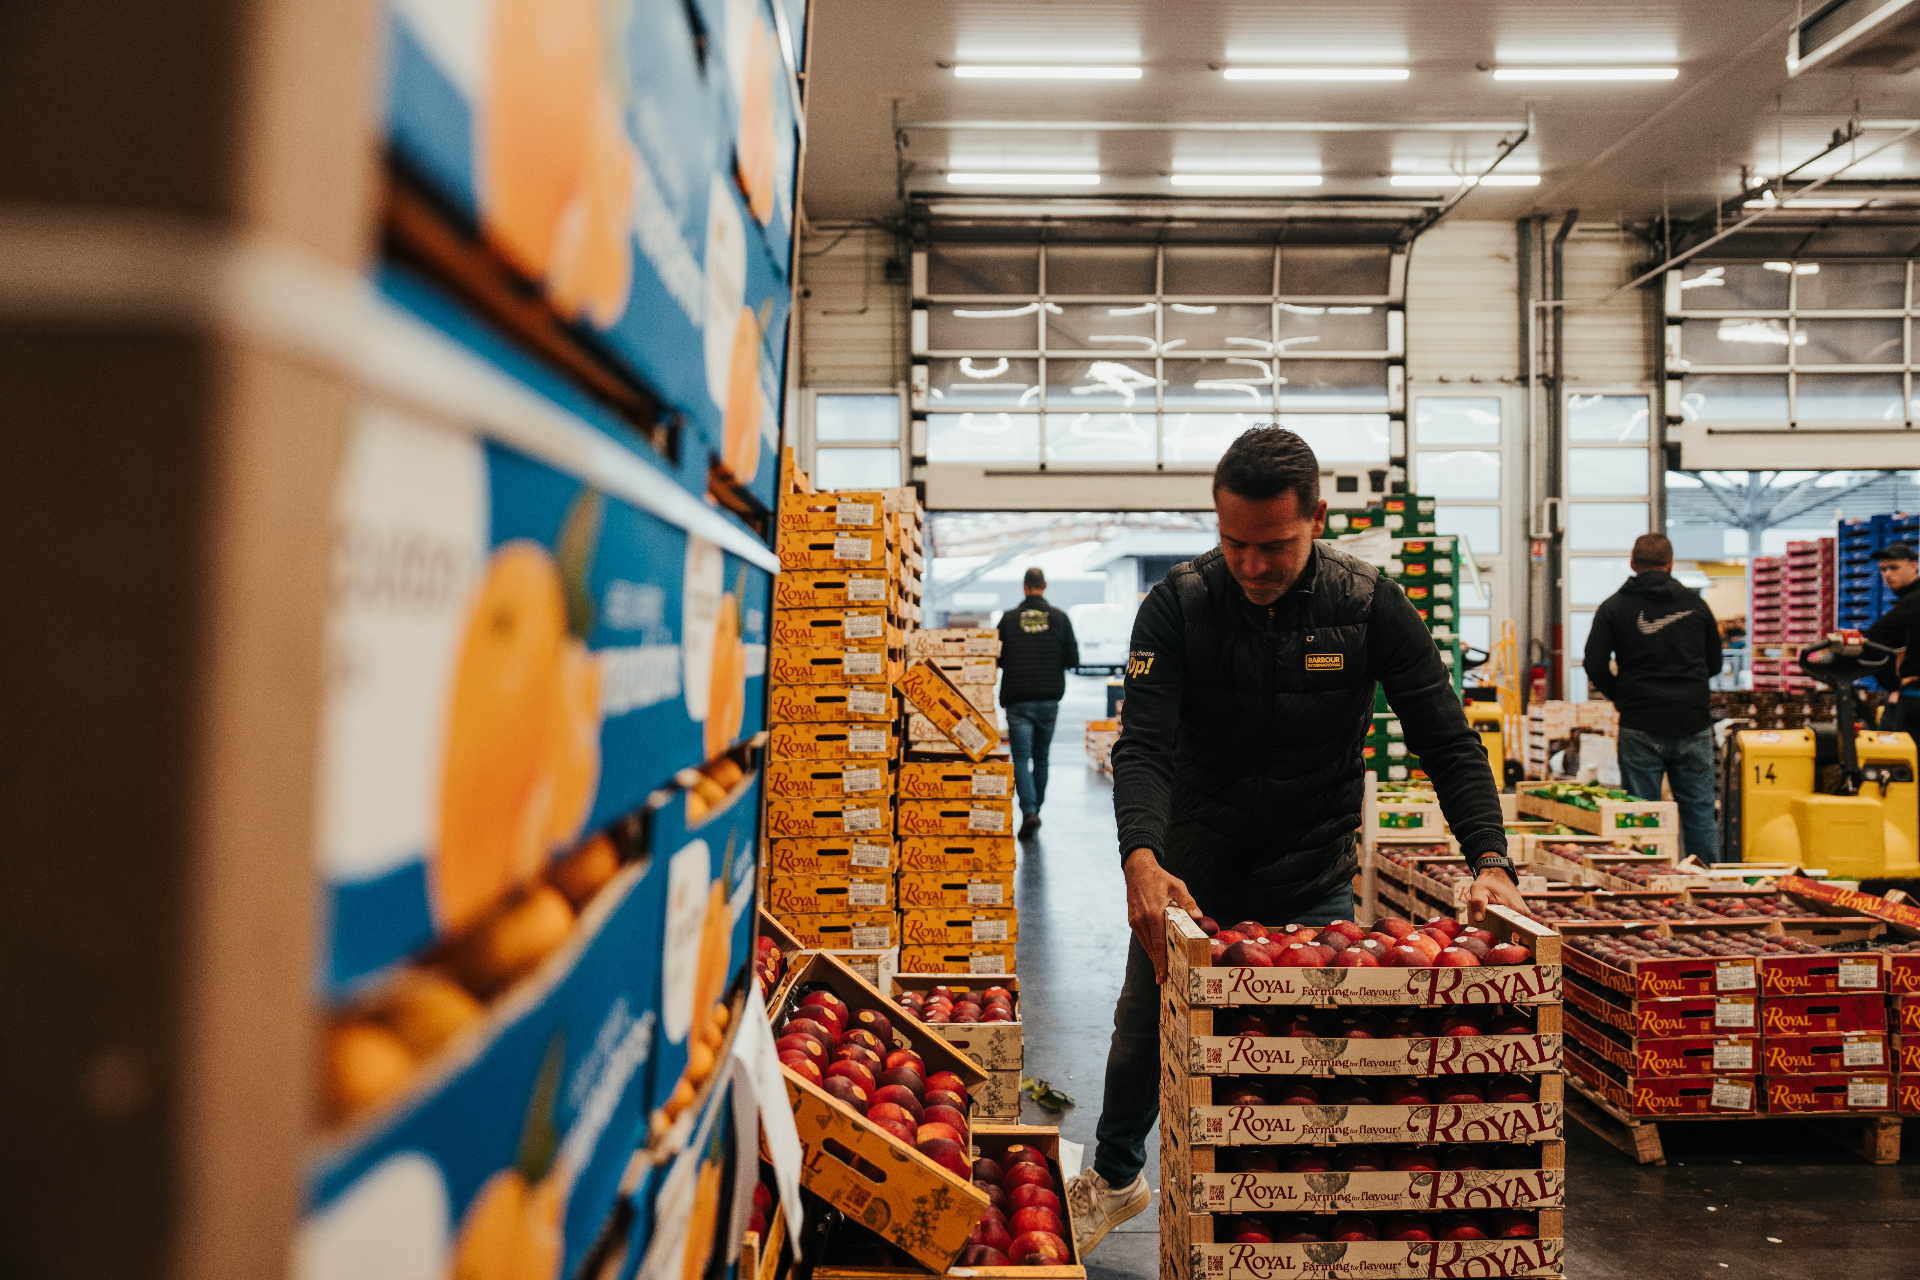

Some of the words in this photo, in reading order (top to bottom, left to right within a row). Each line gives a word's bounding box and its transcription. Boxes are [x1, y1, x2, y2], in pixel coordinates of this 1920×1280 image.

[777, 582, 818, 606] ROYAL
[774, 620, 815, 645] ROYAL
[773, 658, 816, 683] ROYAL
[1308, 656, 1340, 664] BARBOUR
[904, 670, 937, 711] ROYAL
[773, 696, 820, 721] ROYAL
[773, 734, 820, 759] ROYAL
[769, 773, 816, 797] ROYAL
[902, 774, 946, 797] ROYAL
[1753, 763, 1777, 784] 14
[770, 811, 818, 835] ROYAL
[901, 811, 945, 834] ROYAL
[775, 849, 822, 873] ROYAL
[904, 847, 949, 870] ROYAL
[773, 888, 821, 912] ROYAL
[902, 883, 947, 906] ROYAL
[1832, 888, 1882, 911] ROYAL
[906, 920, 950, 943] ROYAL
[904, 955, 948, 973] ROYAL
[1228, 968, 1295, 1003] ROYAL
[1302, 987, 1350, 998] Farming
[1407, 966, 1557, 1004] ROYAL
[1638, 971, 1685, 997] ROYAL
[1764, 967, 1811, 994] ROYAL
[1638, 1010, 1686, 1037] ROYAL
[1764, 1007, 1812, 1033] ROYAL
[1228, 1036, 1295, 1072] ROYAL
[1301, 1056, 1350, 1068] Farming
[1407, 1035, 1557, 1074] ROYAL
[1638, 1050, 1686, 1076] ROYAL
[1766, 1047, 1815, 1073] ROYAL
[1633, 1088, 1683, 1113] ROYAL
[1770, 1085, 1819, 1111] ROYAL
[1228, 1105, 1296, 1141] ROYAL
[1302, 1125, 1350, 1136] Farming
[1407, 1103, 1557, 1141] ROYAL
[1230, 1174, 1297, 1209] ROYAL
[1304, 1192, 1351, 1203] Farming
[1409, 1171, 1559, 1208] ROYAL
[1229, 1244, 1296, 1279] ROYAL
[1303, 1261, 1350, 1273] Farming
[1407, 1240, 1558, 1278] ROYAL
